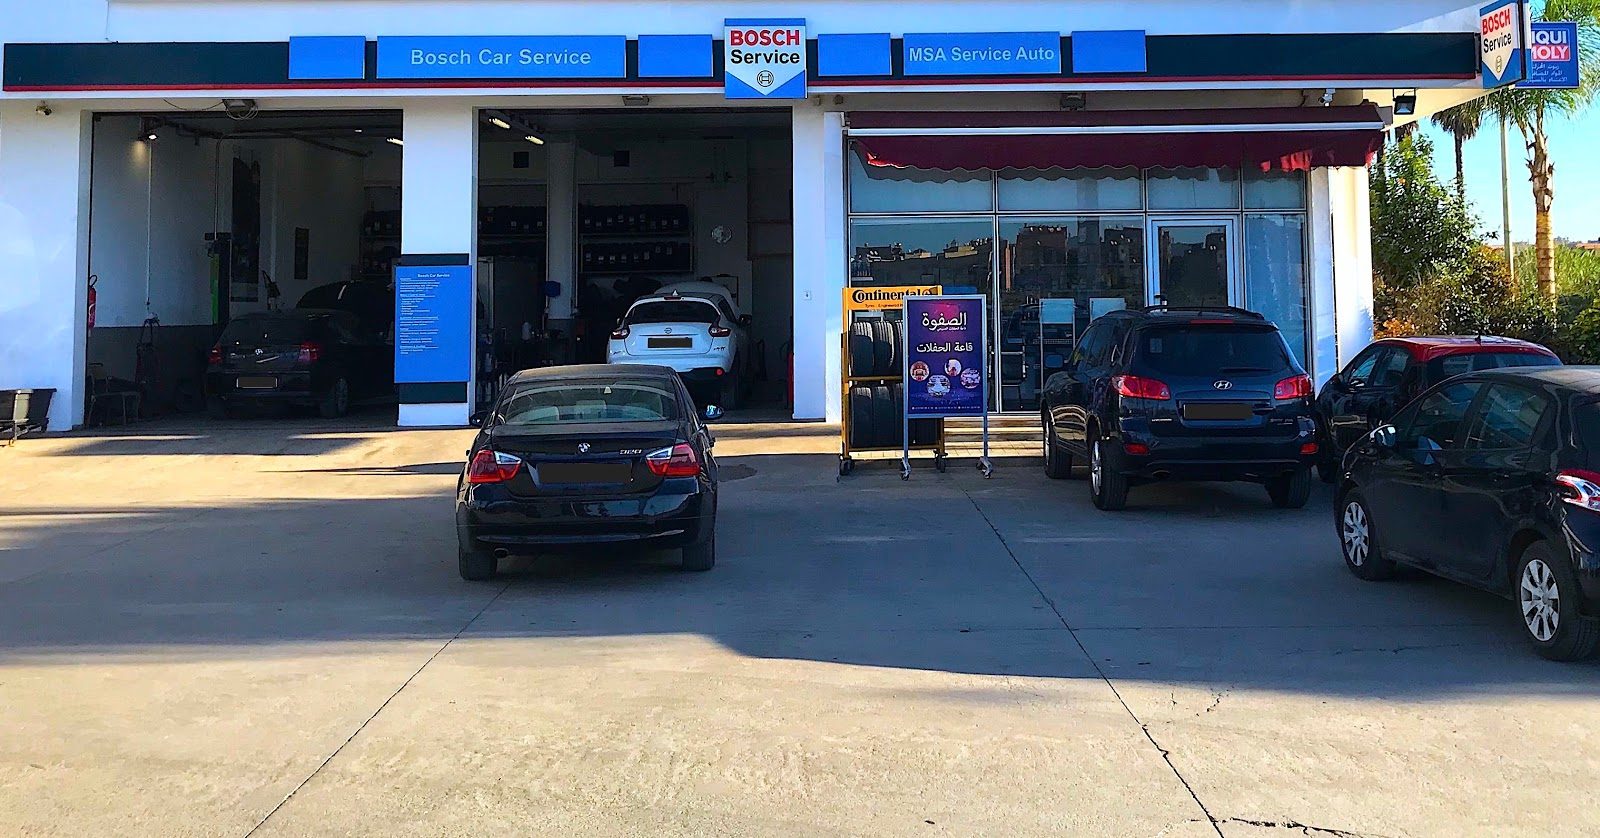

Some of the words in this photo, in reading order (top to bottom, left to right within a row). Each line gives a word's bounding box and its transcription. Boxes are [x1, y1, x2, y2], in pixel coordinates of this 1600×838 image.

[1482, 9, 1511, 35] BOSCH
[730, 29, 800, 47] BOSCH
[1483, 32, 1512, 54] Service
[1531, 30, 1567, 45] IQUI
[411, 49, 471, 65] Bosch
[478, 49, 513, 65] Car
[519, 48, 591, 65] Service
[730, 49, 800, 64] Service
[909, 47, 947, 62] MSA
[951, 46, 1012, 62] Service
[1016, 46, 1055, 61] Auto
[922, 312, 967, 331] الصفوة
[916, 342, 951, 353] الحفلات
[954, 342, 973, 352] قاعة
